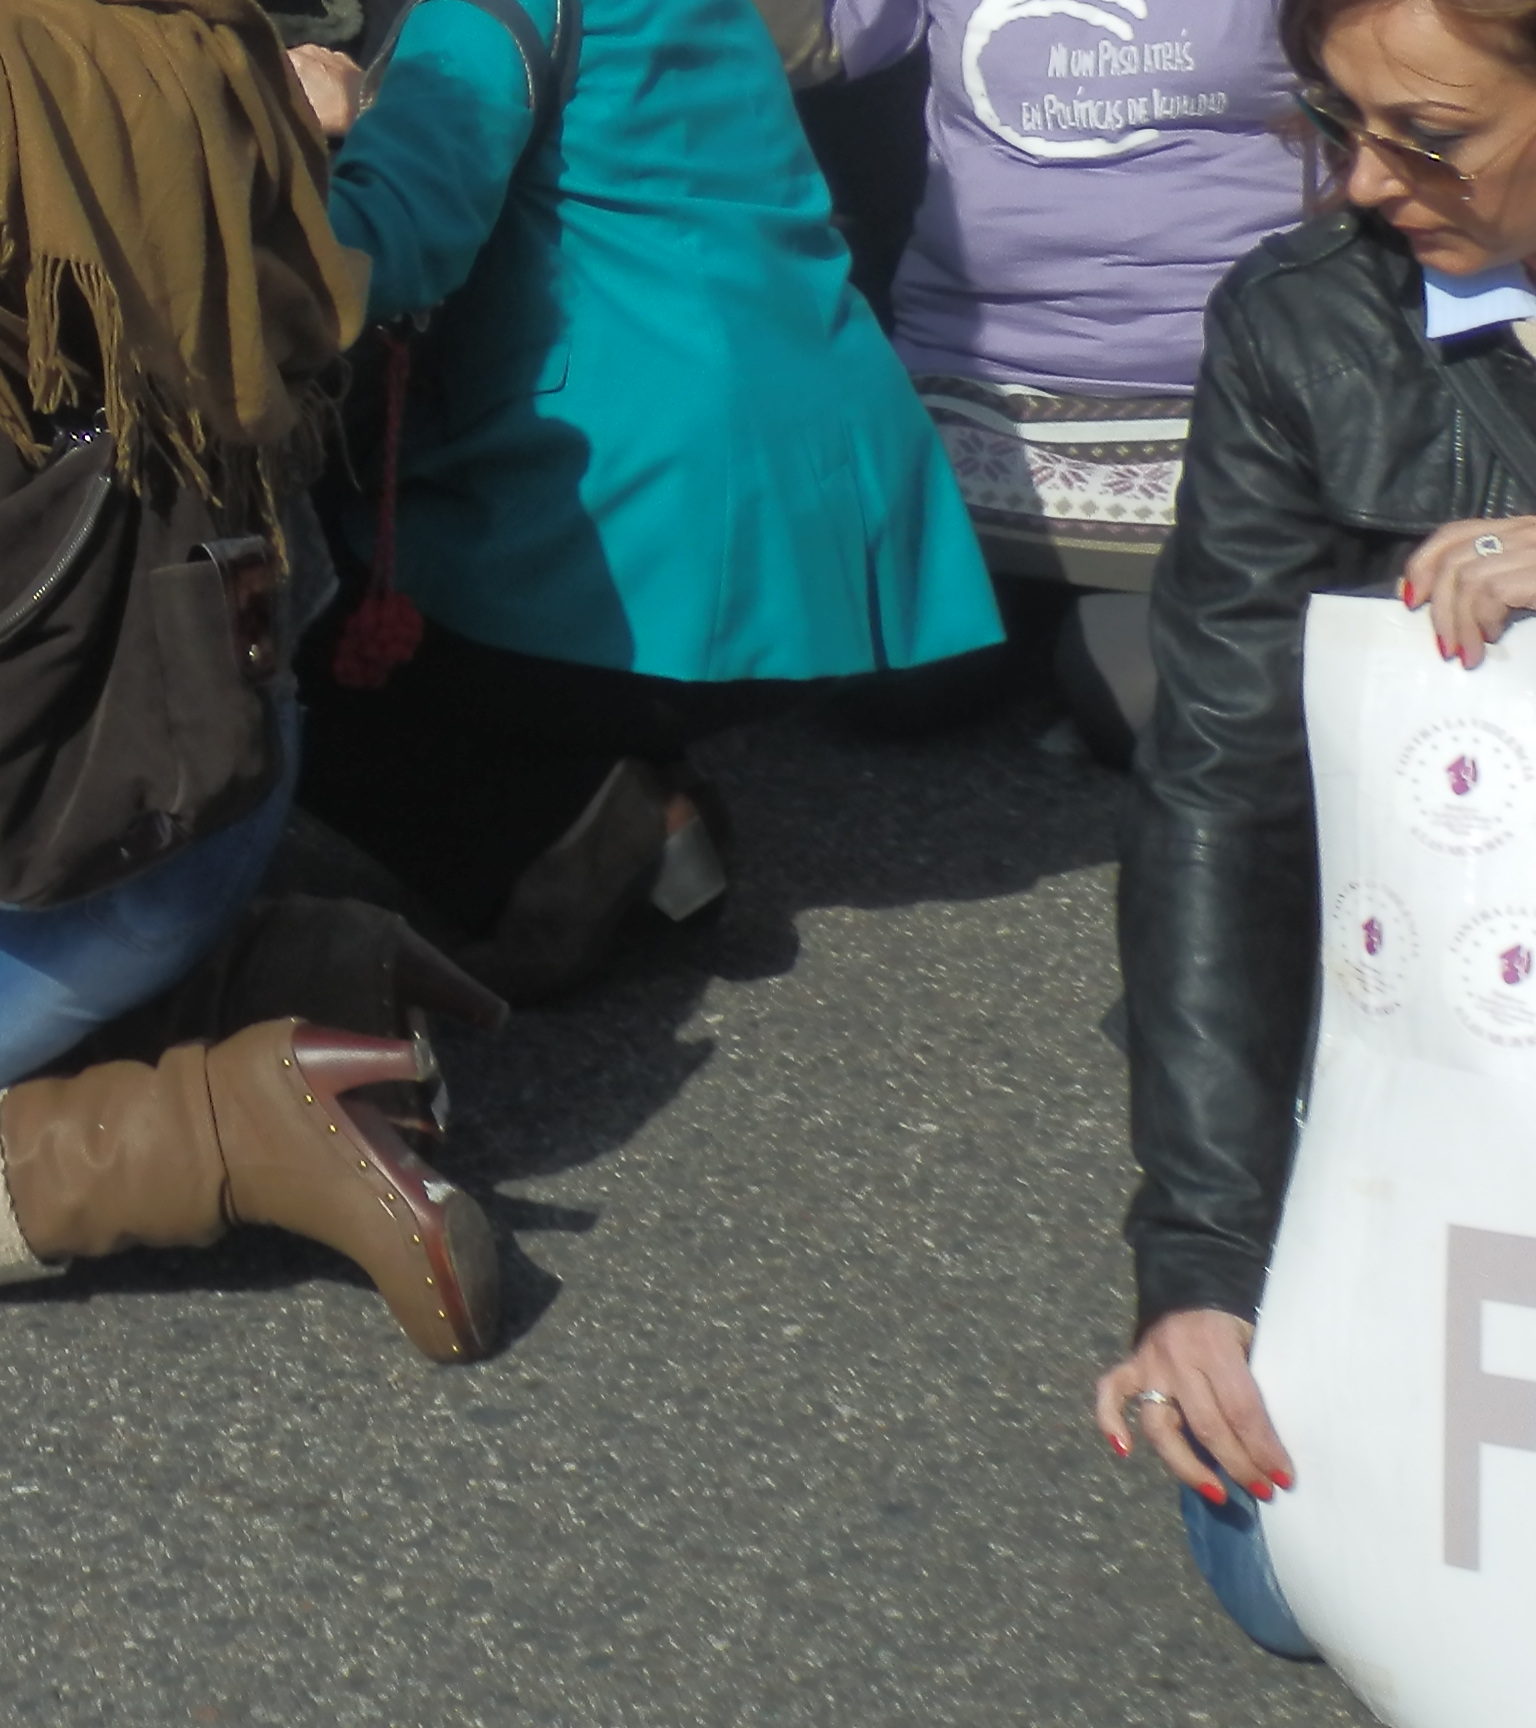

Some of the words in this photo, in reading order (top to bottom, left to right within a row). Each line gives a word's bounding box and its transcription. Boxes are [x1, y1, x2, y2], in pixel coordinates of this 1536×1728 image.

[1098, 39, 1138, 77] PASO
[1043, 86, 1123, 131] POLÍTICAS
[1127, 97, 1150, 126] DE
